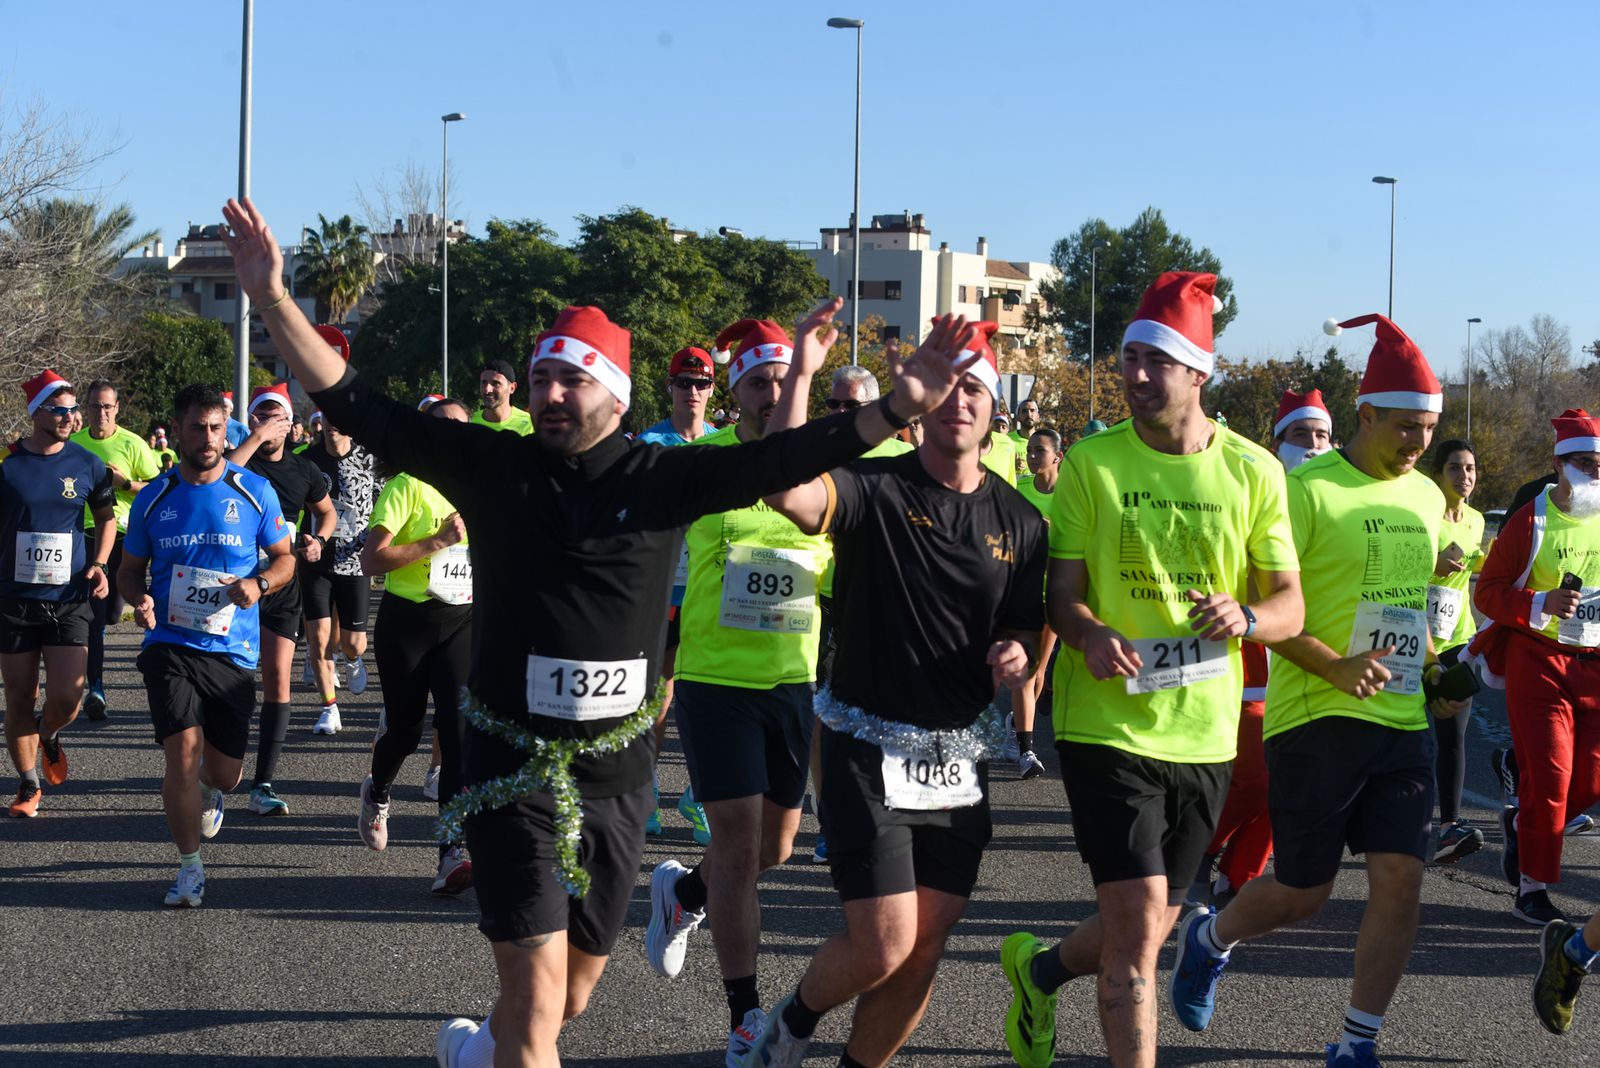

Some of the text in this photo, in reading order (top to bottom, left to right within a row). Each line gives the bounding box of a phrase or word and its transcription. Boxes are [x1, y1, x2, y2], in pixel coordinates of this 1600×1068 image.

[1150, 500, 1222, 513] ANIVERSARIO
[160, 533, 243, 549] TROTASIERRA
[25, 547, 63, 563] 1075
[442, 562, 473, 579] 1447
[1120, 569, 1149, 582] SAN
[747, 572, 794, 597] 893
[185, 586, 221, 607] 294
[1369, 628, 1419, 658] 1029
[1153, 638, 1201, 669] 211
[549, 666, 627, 698] 1322
